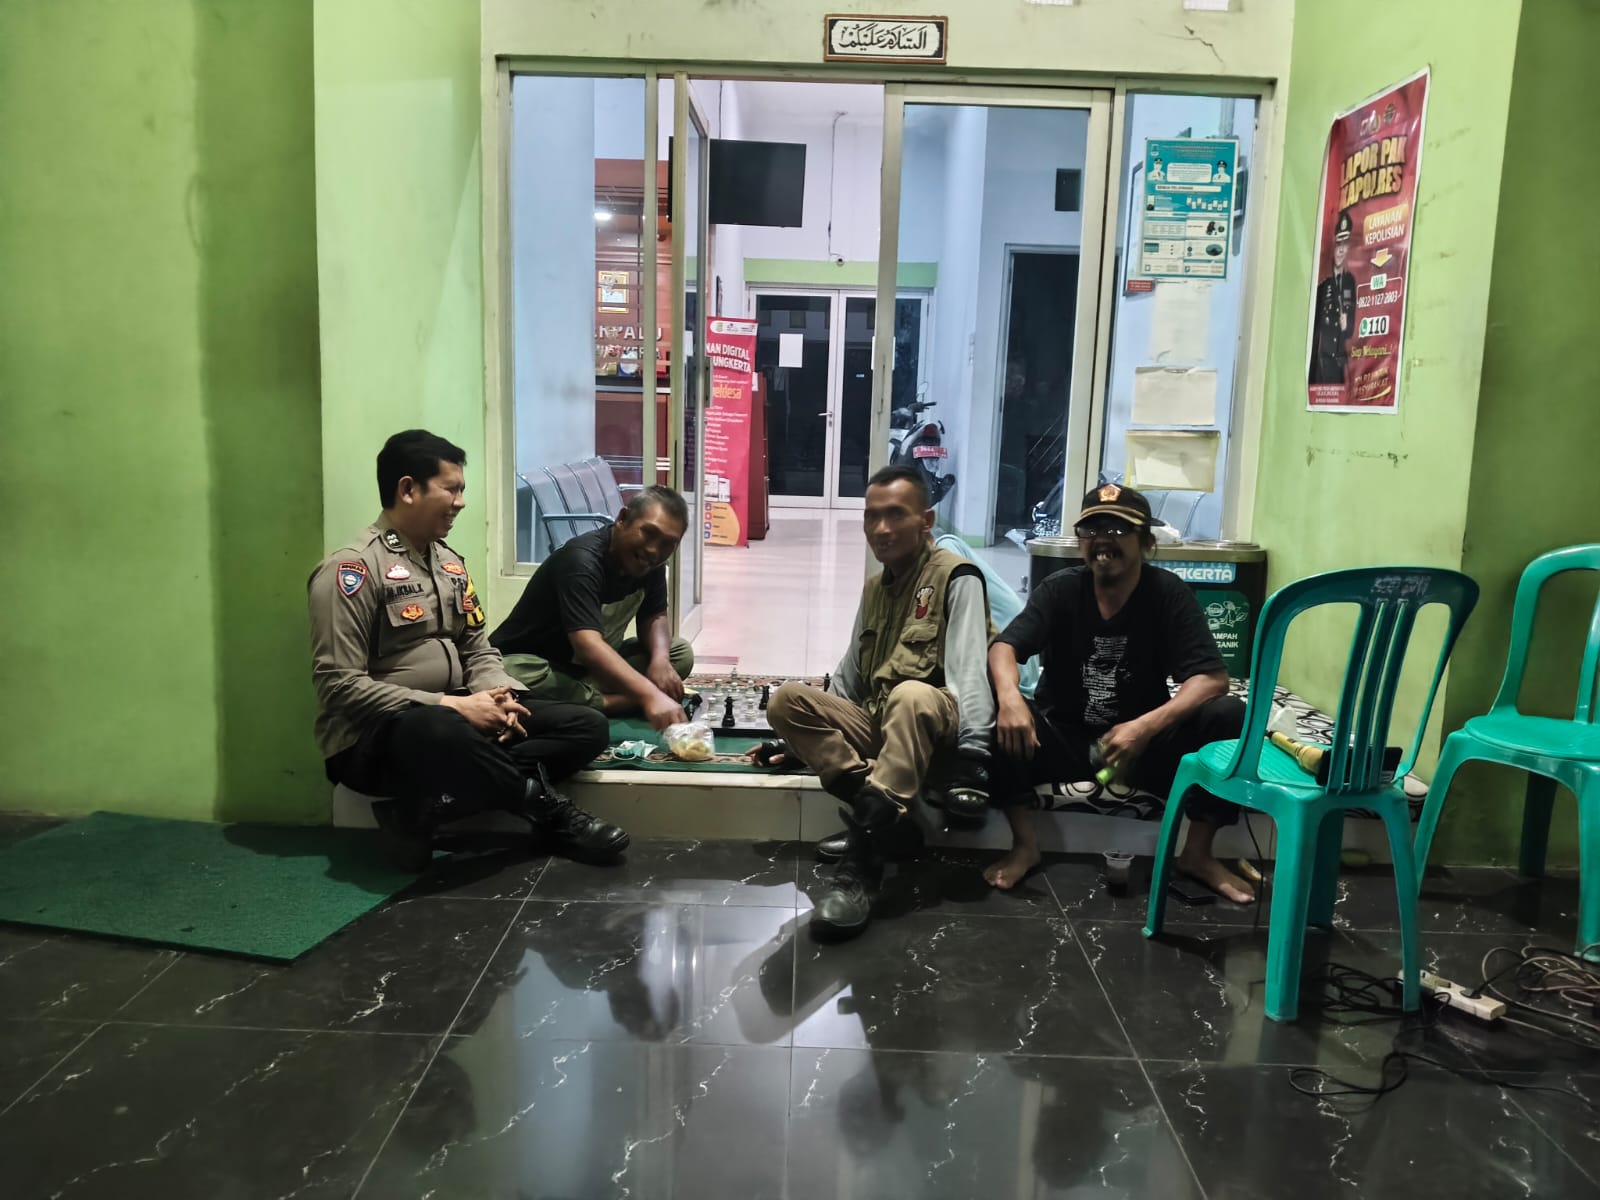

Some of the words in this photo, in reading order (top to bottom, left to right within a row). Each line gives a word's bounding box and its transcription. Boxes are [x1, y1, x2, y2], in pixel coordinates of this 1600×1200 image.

[1341, 143, 1378, 184] LAPOR
[1380, 136, 1407, 166] PAK
[1339, 165, 1402, 211] KAPOLRES
[1365, 224, 1405, 245] KEPOLISIAN
[1369, 317, 1387, 335] 110
[722, 344, 750, 360] DIGITAL
